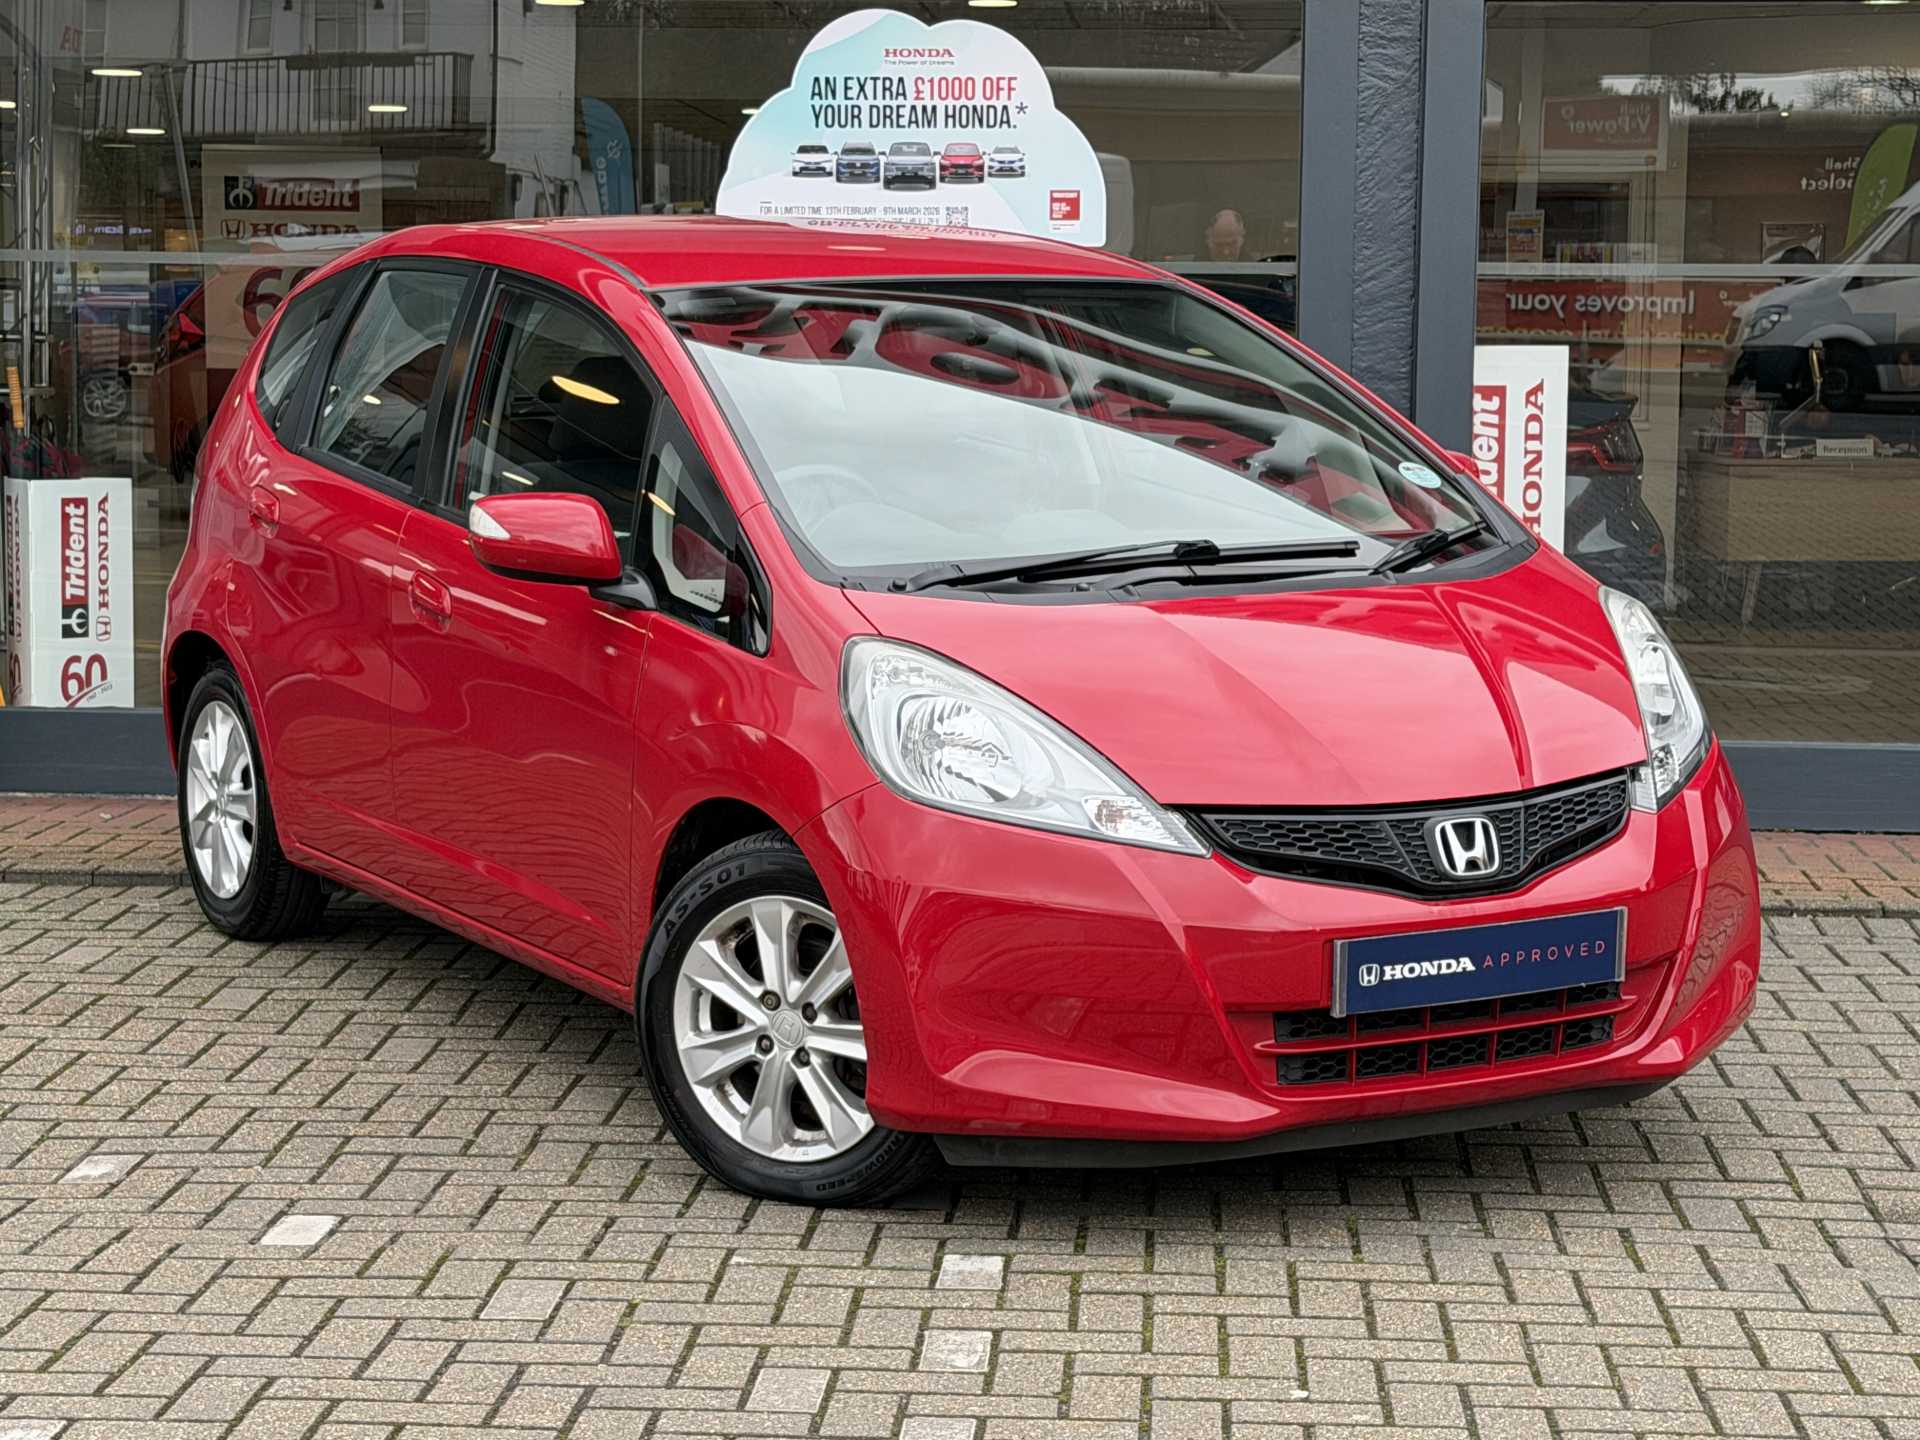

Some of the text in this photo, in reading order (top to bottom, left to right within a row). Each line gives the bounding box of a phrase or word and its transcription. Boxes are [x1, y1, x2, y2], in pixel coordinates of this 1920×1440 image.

[884, 48, 956, 58] HONDA
[811, 76, 1018, 101] AN EXTRA £1000 OFF
[810, 104, 862, 129] YOUR
[869, 104, 937, 129] DREAM
[263, 182, 356, 208] Trident
[759, 205, 772, 215] FOR
[64, 502, 86, 600] Trident
[98, 492, 110, 612] HONDA
[1382, 940, 1607, 982] HONDA APPROVED
